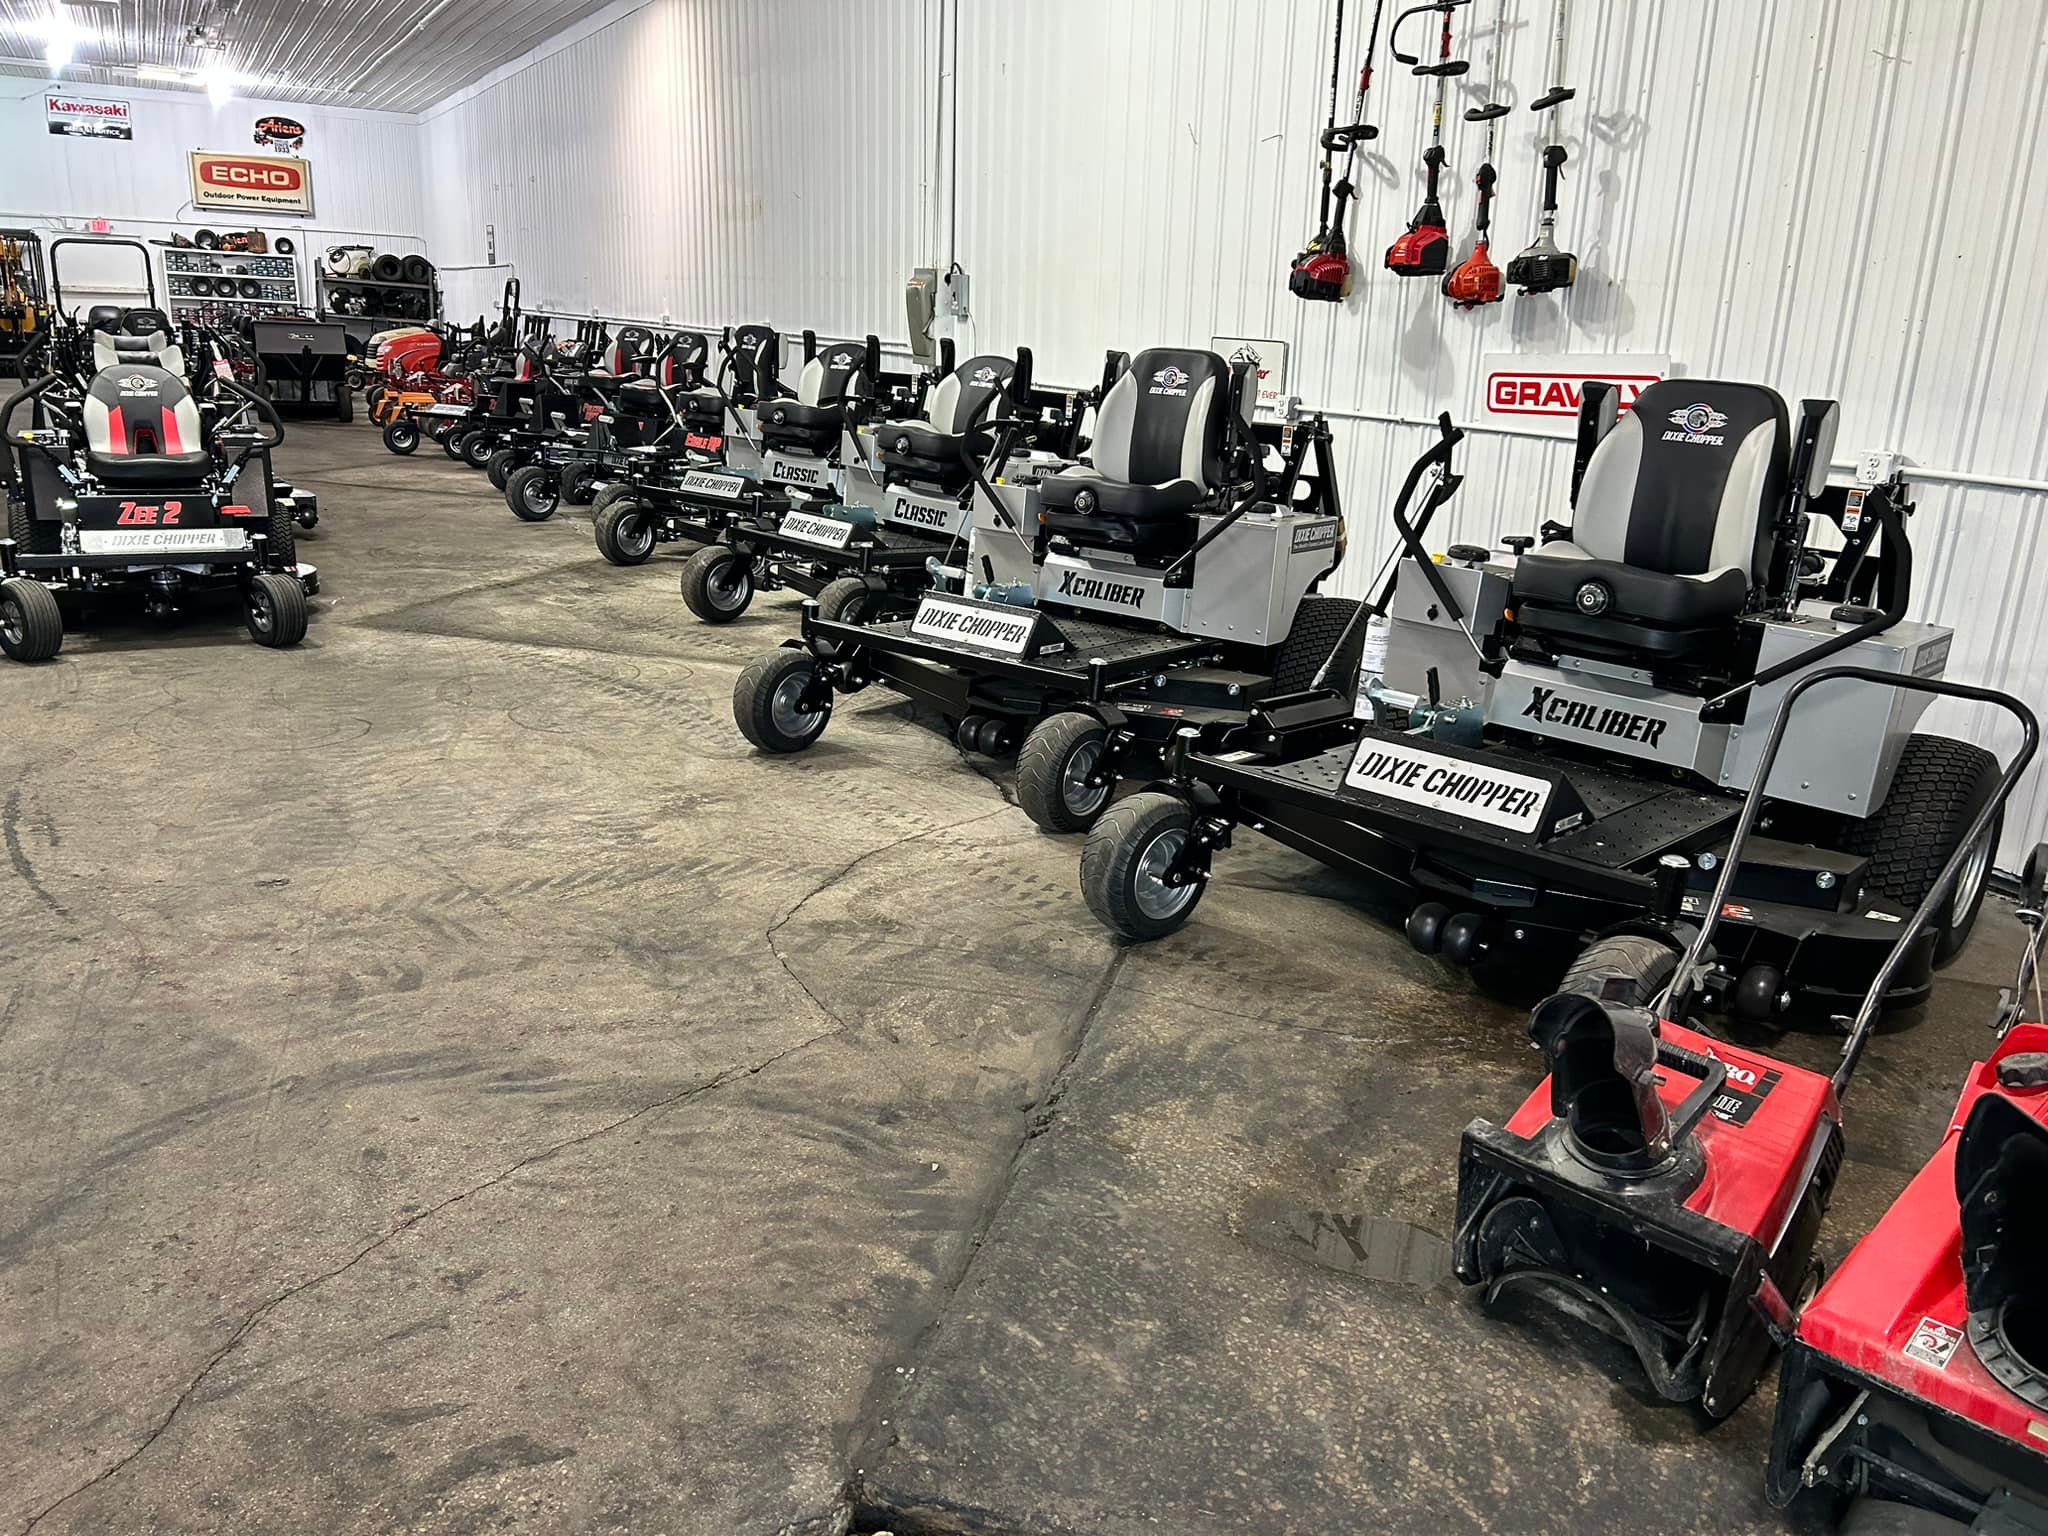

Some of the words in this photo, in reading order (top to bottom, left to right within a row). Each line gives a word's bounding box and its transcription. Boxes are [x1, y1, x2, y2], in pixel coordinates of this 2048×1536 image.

[49, 99, 128, 117] Kawasaki
[258, 119, 302, 134] Ariens
[211, 165, 290, 186] ECHO
[203, 191, 235, 200] Outdoor
[236, 193, 260, 201] Power
[261, 195, 302, 205] Equipment
[1661, 430, 1686, 444] DIXIE
[1684, 432, 1725, 446] CHOPPER
[684, 475, 708, 488] DIXIE
[704, 478, 741, 493] CHOPPER
[772, 461, 819, 484] CLASSIC
[162, 501, 183, 524] 2
[893, 497, 948, 527] CLASSIC
[112, 535, 150, 547] DIXIE
[152, 533, 217, 546] CHOPPER
[783, 516, 809, 534] DIXIE
[806, 520, 849, 542] CHOPPER
[1057, 570, 1146, 609] XCALIBER
[918, 606, 962, 630] DIXIE
[958, 613, 1026, 644] CHOPPER
[1521, 685, 1668, 750] XCALIBER
[1357, 750, 1428, 790] DIXIE
[1422, 767, 1541, 819] CHOPPER
